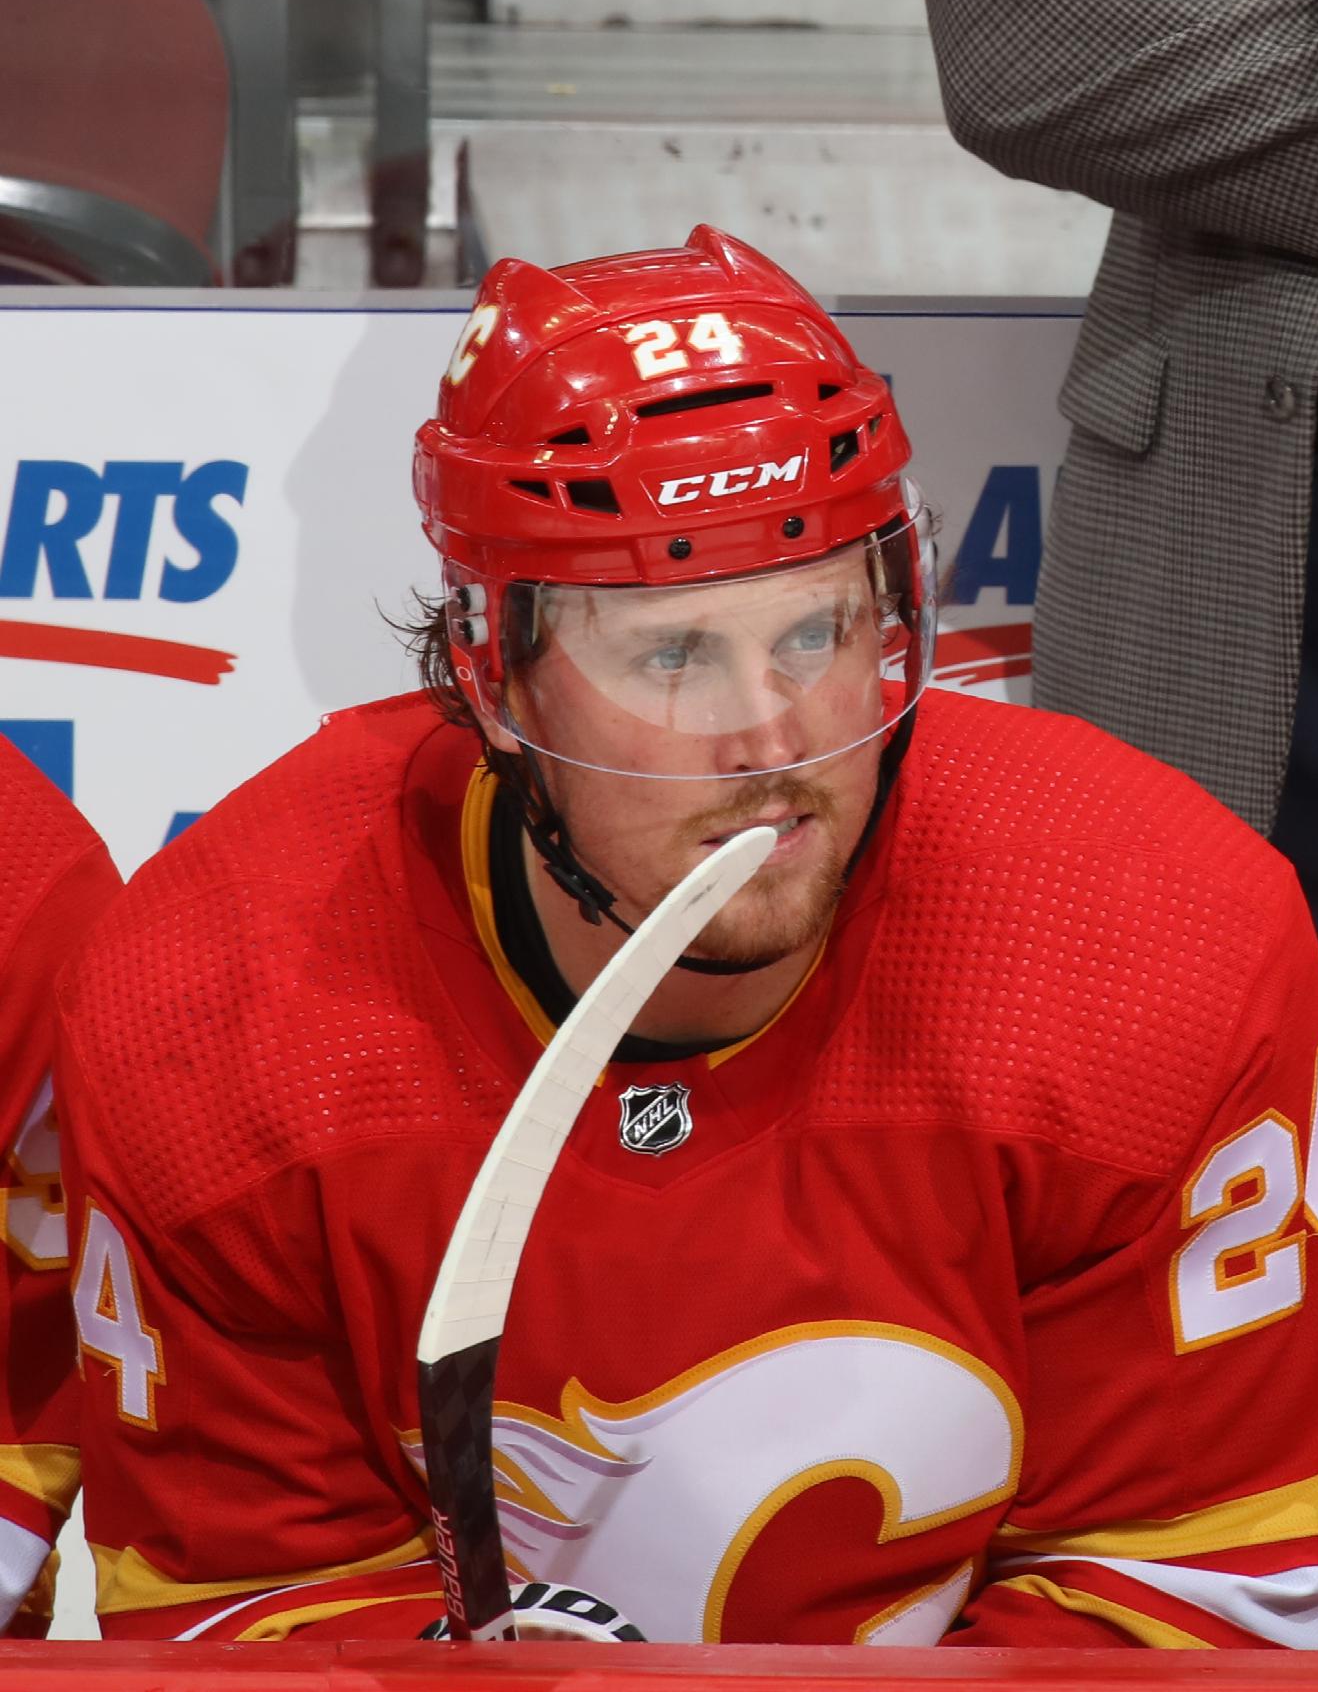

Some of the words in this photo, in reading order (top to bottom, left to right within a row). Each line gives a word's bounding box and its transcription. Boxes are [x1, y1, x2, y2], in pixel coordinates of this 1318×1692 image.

[624, 312, 743, 380] 24
[656, 453, 804, 507] CCM
[634, 1098, 674, 1142] NHL
